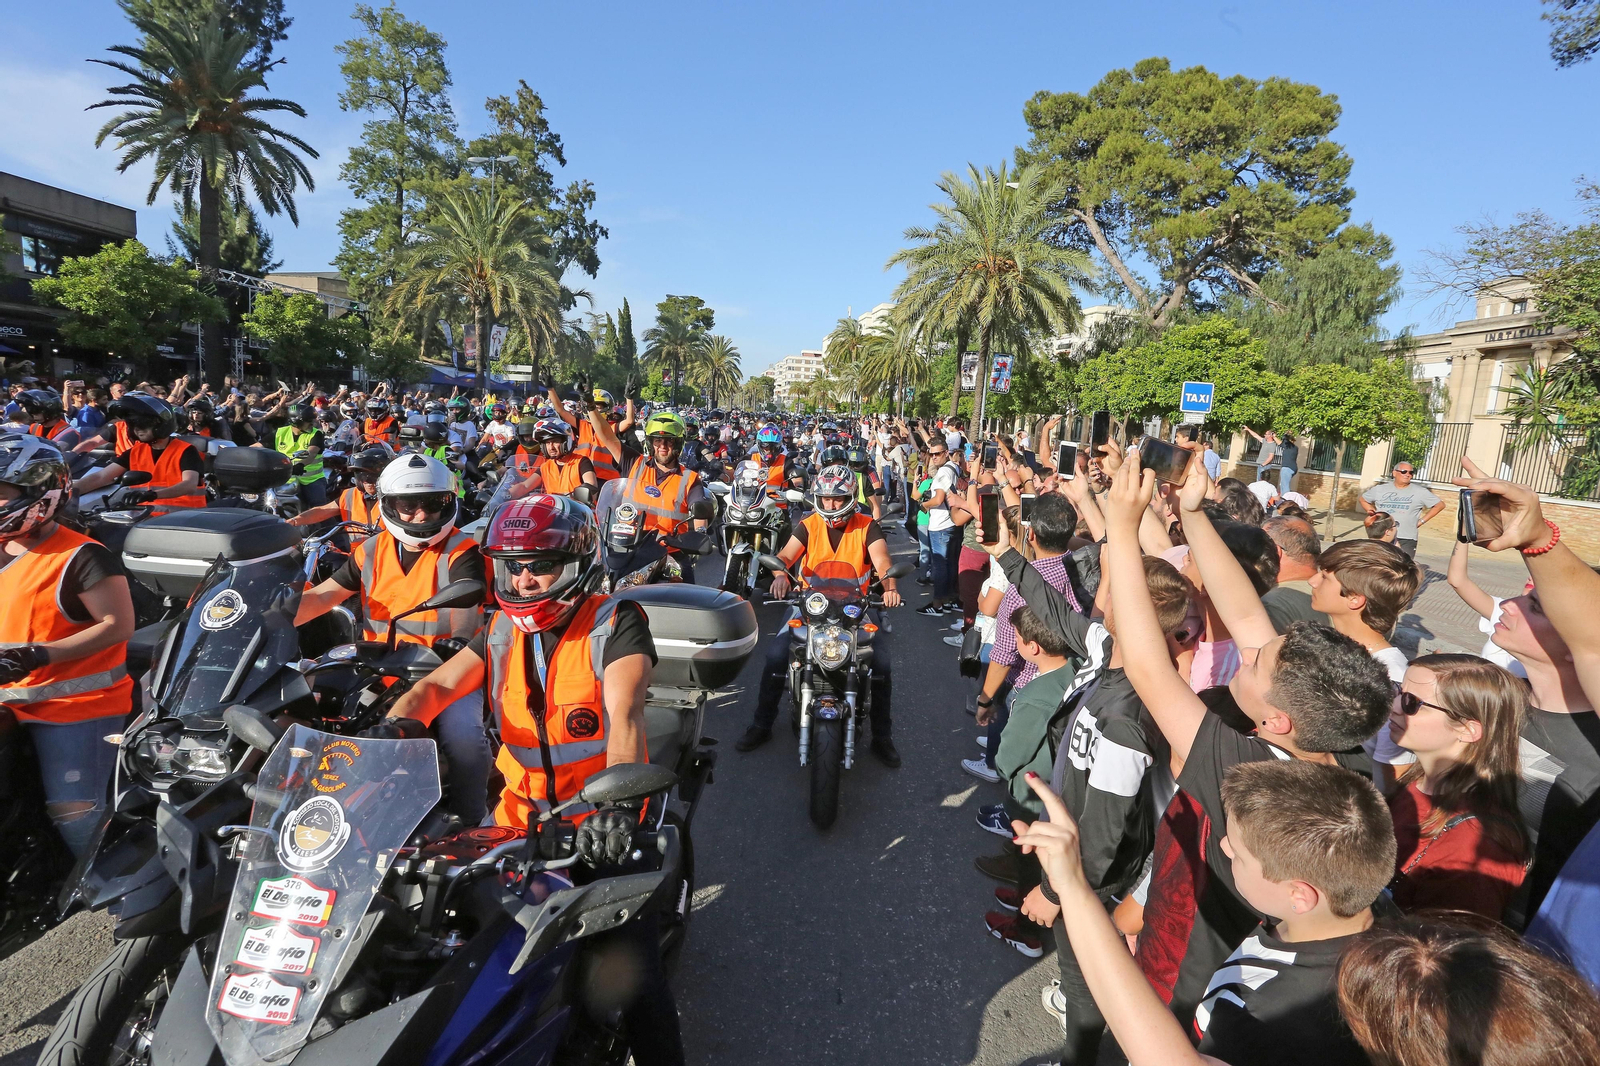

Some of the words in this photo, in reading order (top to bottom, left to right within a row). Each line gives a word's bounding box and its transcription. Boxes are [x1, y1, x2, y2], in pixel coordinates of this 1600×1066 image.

[1485, 326, 1553, 342] INSTITUTO
[1185, 393, 1209, 403] TAXI
[1382, 491, 1414, 502] Road
[503, 519, 531, 529] SHOEI
[323, 741, 340, 752] CLUB
[340, 740, 361, 757] MOTERO
[322, 773, 340, 781] XEREZ
[316, 782, 348, 793] GASOLINA
[293, 803, 313, 825] CONSEJO
[314, 800, 330, 808] LOCAL
[329, 804, 338, 814] DEL
[293, 846, 314, 857] JEREZ
[284, 880, 302, 890] 378
[297, 913, 319, 922] 2019
[254, 942, 306, 961] Deafío
[282, 963, 304, 971] 2017
[250, 977, 272, 990] 241
[239, 990, 291, 1010] Deafío
[266, 1010, 289, 1019] 2018
